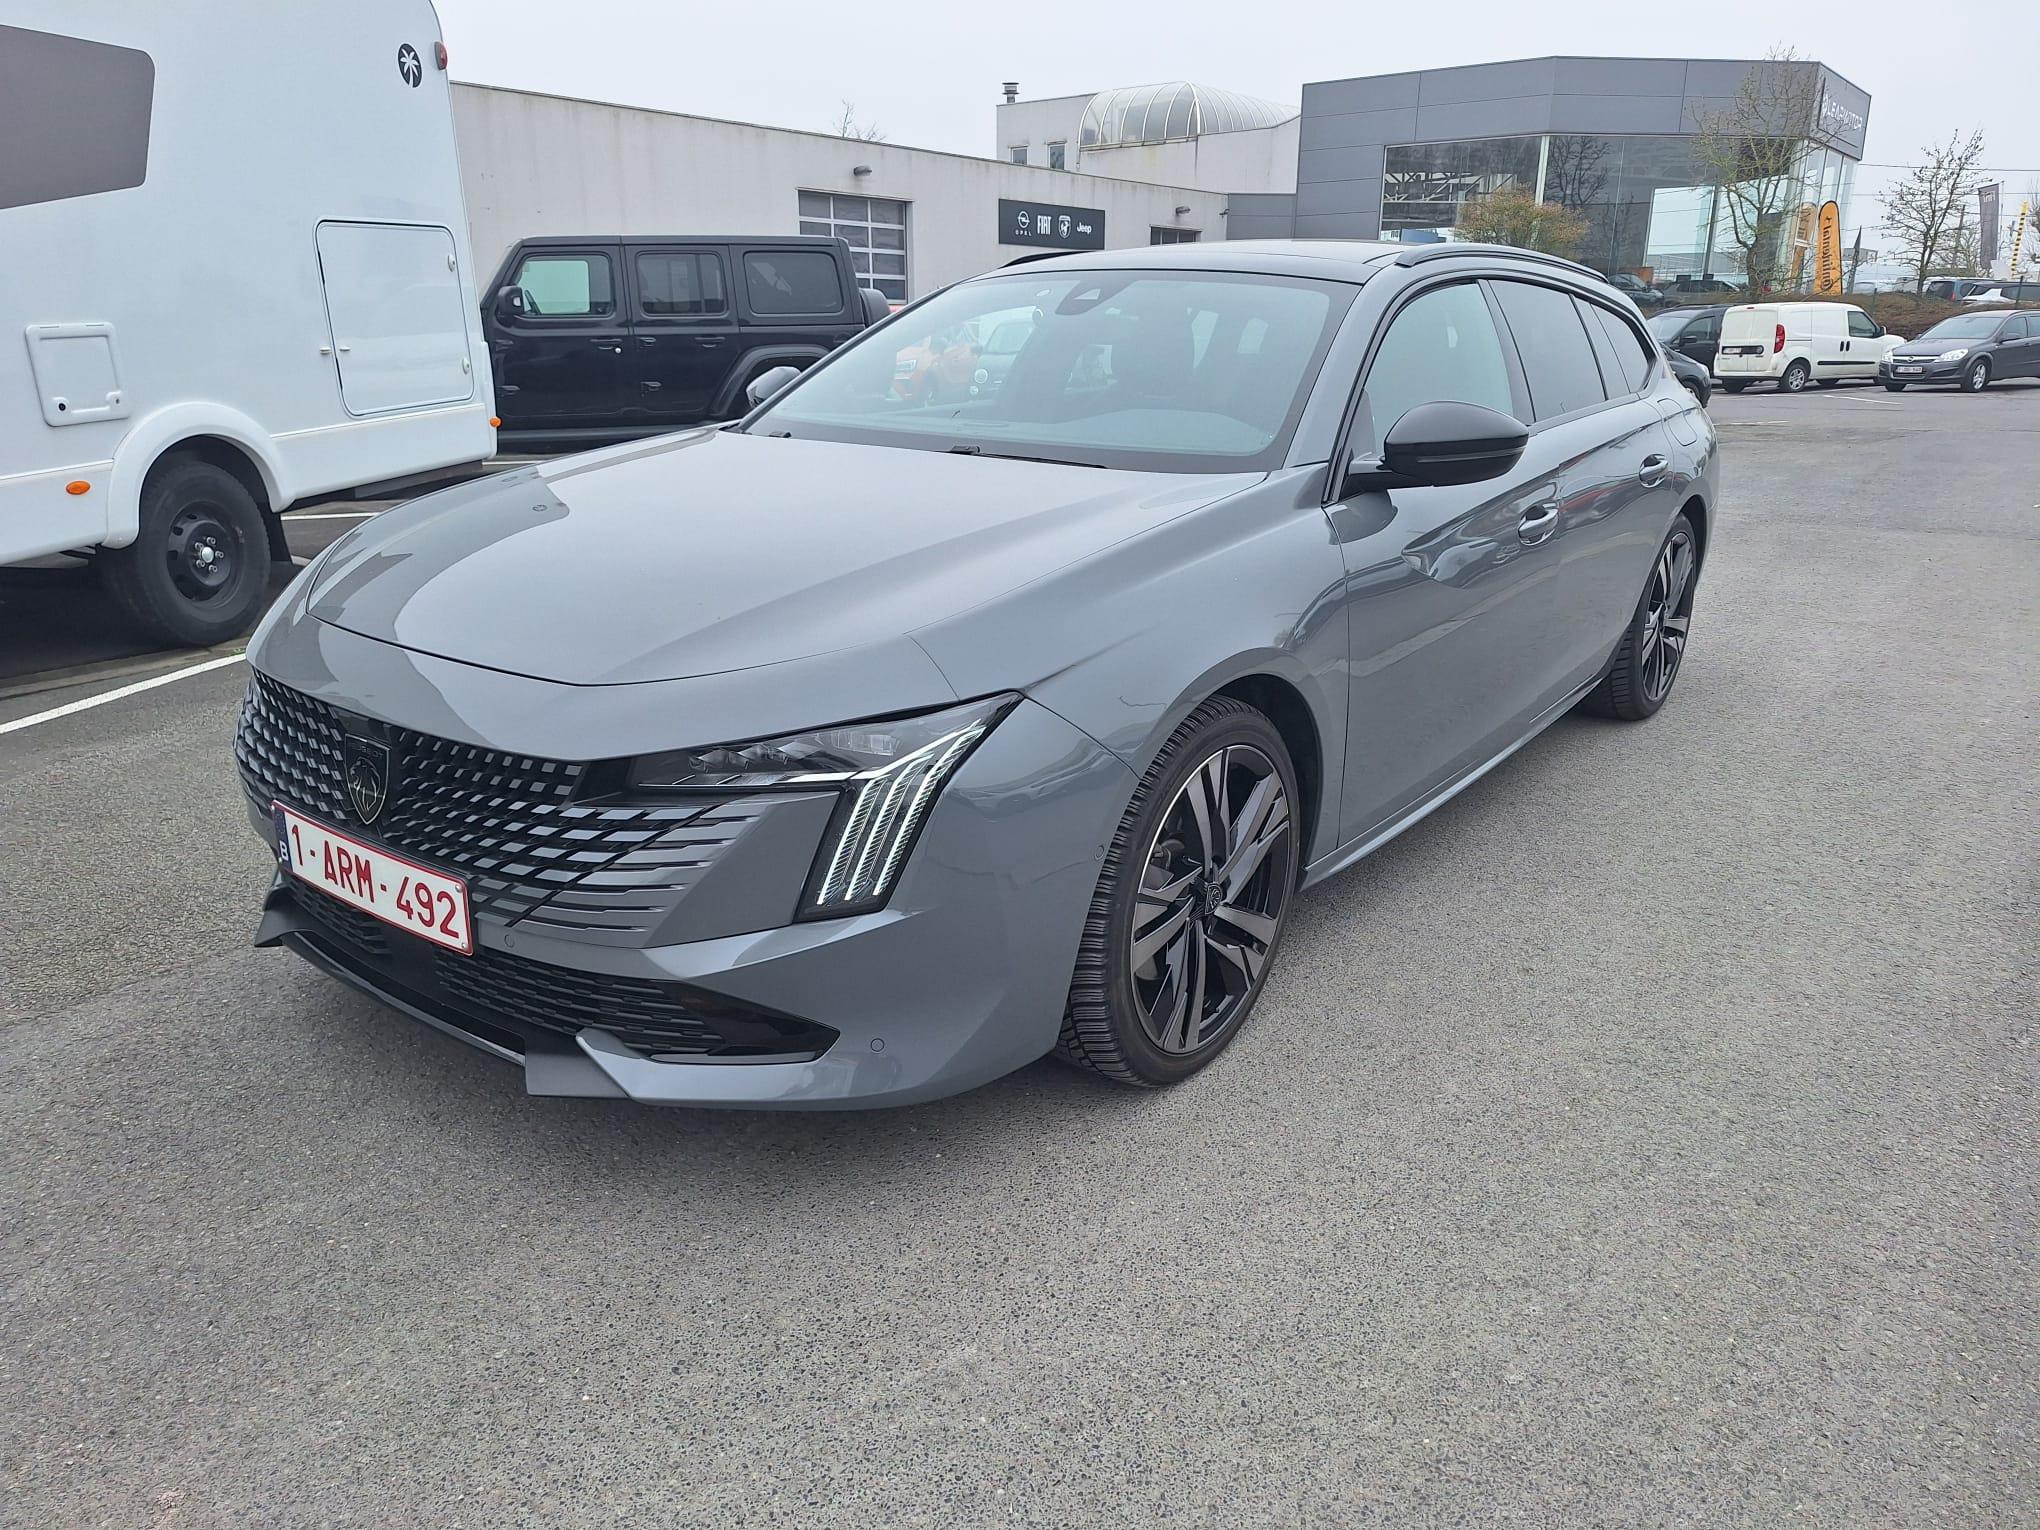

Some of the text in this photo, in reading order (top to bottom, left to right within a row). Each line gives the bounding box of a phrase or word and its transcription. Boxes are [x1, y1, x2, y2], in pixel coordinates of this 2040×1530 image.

[1015, 229, 1032, 237] OPEL
[1037, 215, 1051, 235] FIAT
[1077, 222, 1092, 235] Jeep
[279, 840, 289, 861] B
[291, 824, 460, 939] 1-ARM-492
